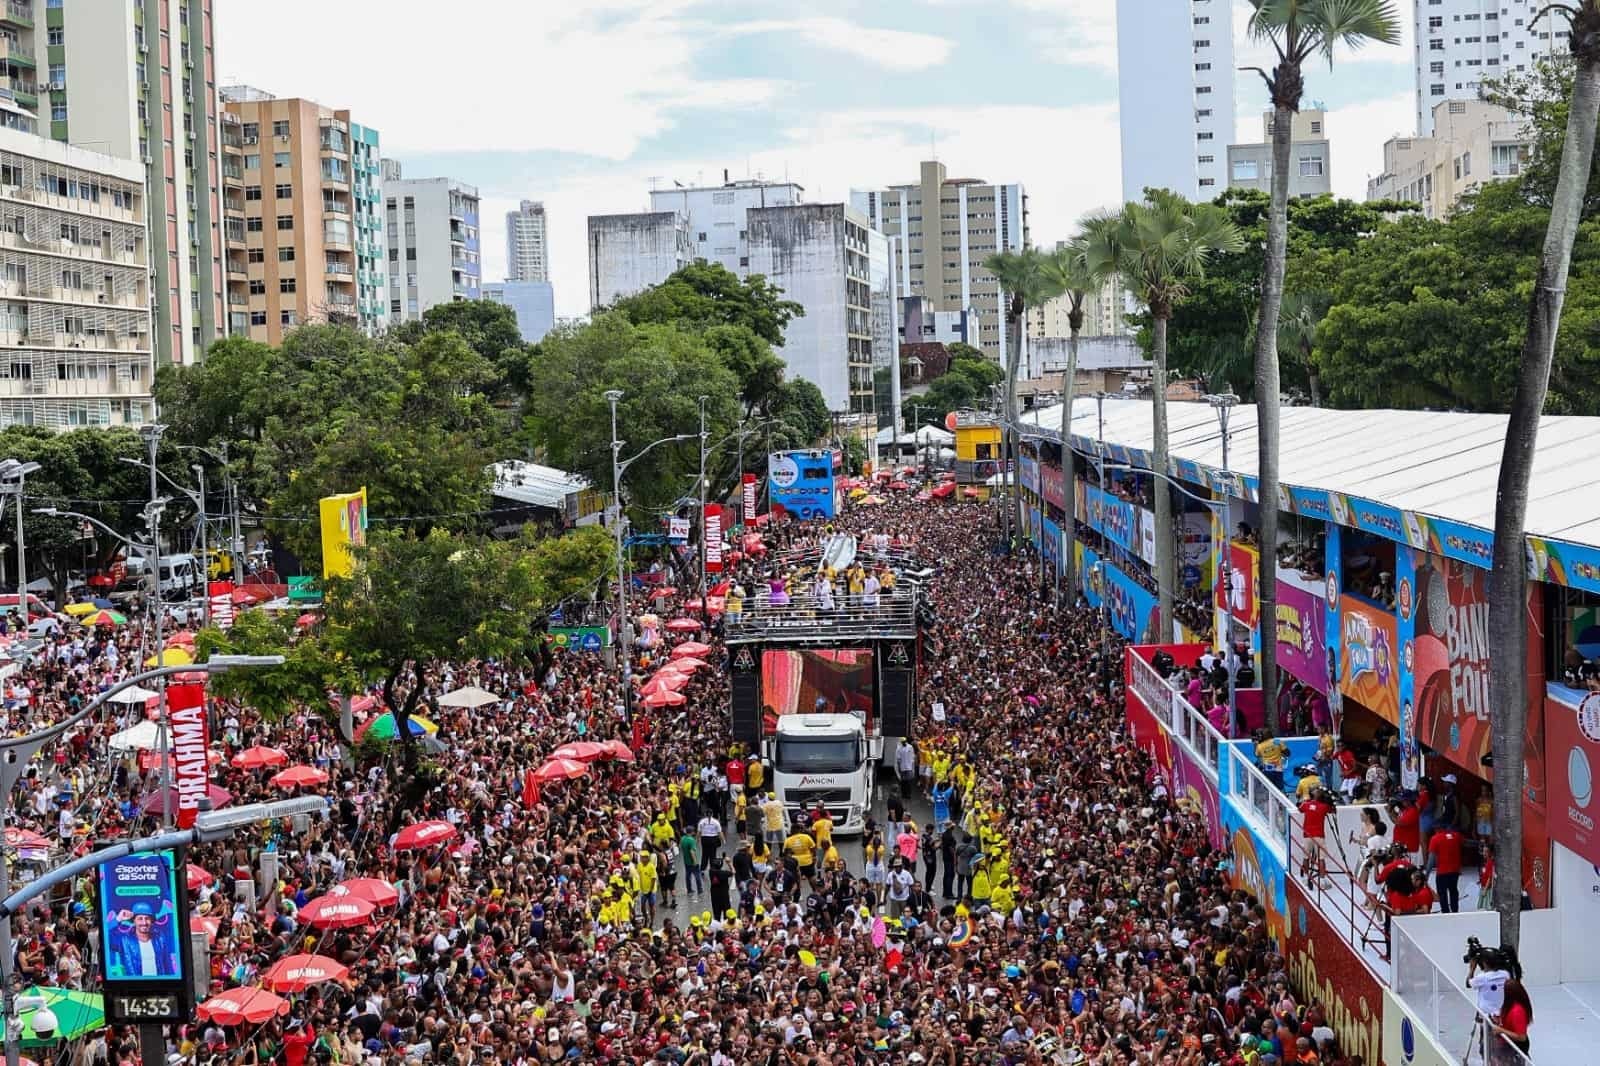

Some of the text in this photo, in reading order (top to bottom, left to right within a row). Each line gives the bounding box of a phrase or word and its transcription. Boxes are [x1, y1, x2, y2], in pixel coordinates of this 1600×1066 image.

[705, 515, 721, 562] BRAHMA
[172, 706, 206, 809] BRAHMA
[130, 873, 157, 881] Sorte
[120, 998, 171, 1016] 14:33
